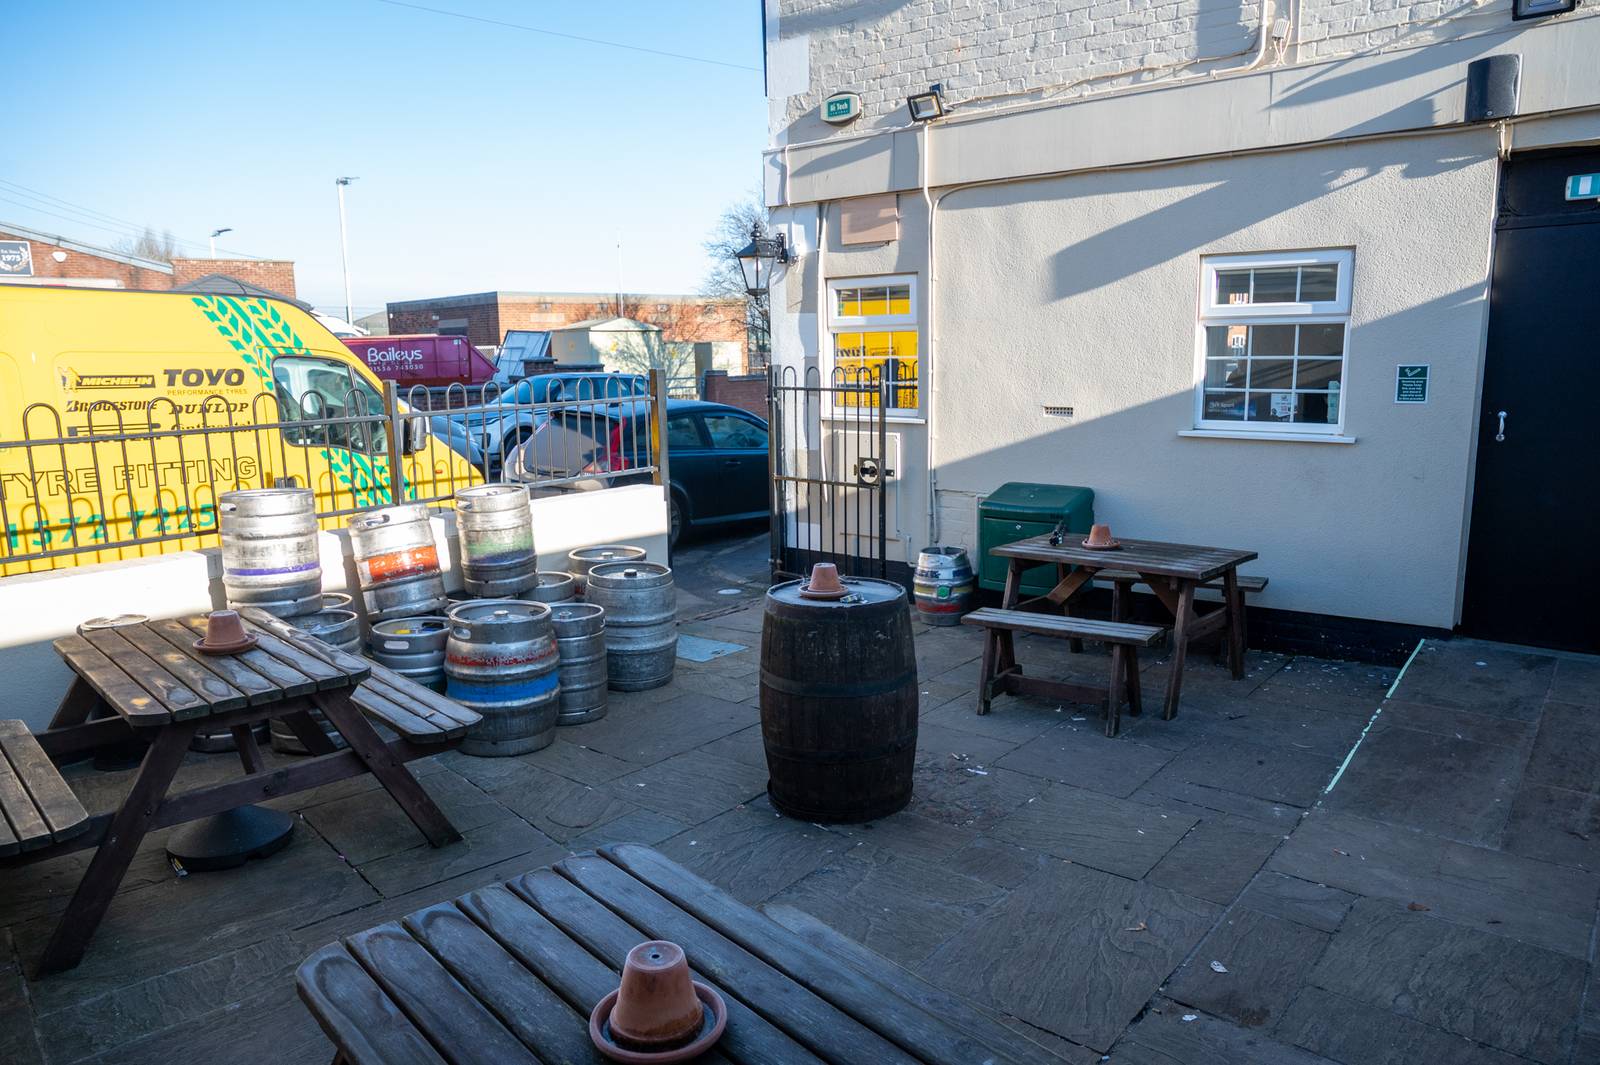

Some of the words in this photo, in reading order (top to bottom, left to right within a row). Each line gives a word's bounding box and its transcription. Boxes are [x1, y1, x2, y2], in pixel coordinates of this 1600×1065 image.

[368, 347, 422, 364] Baileys
[81, 376, 153, 386] MICHELIN
[163, 368, 245, 387] TOYO
[169, 402, 249, 415] DUNLOP
[0, 467, 99, 500] TYRE
[113, 456, 257, 491] FITTING
